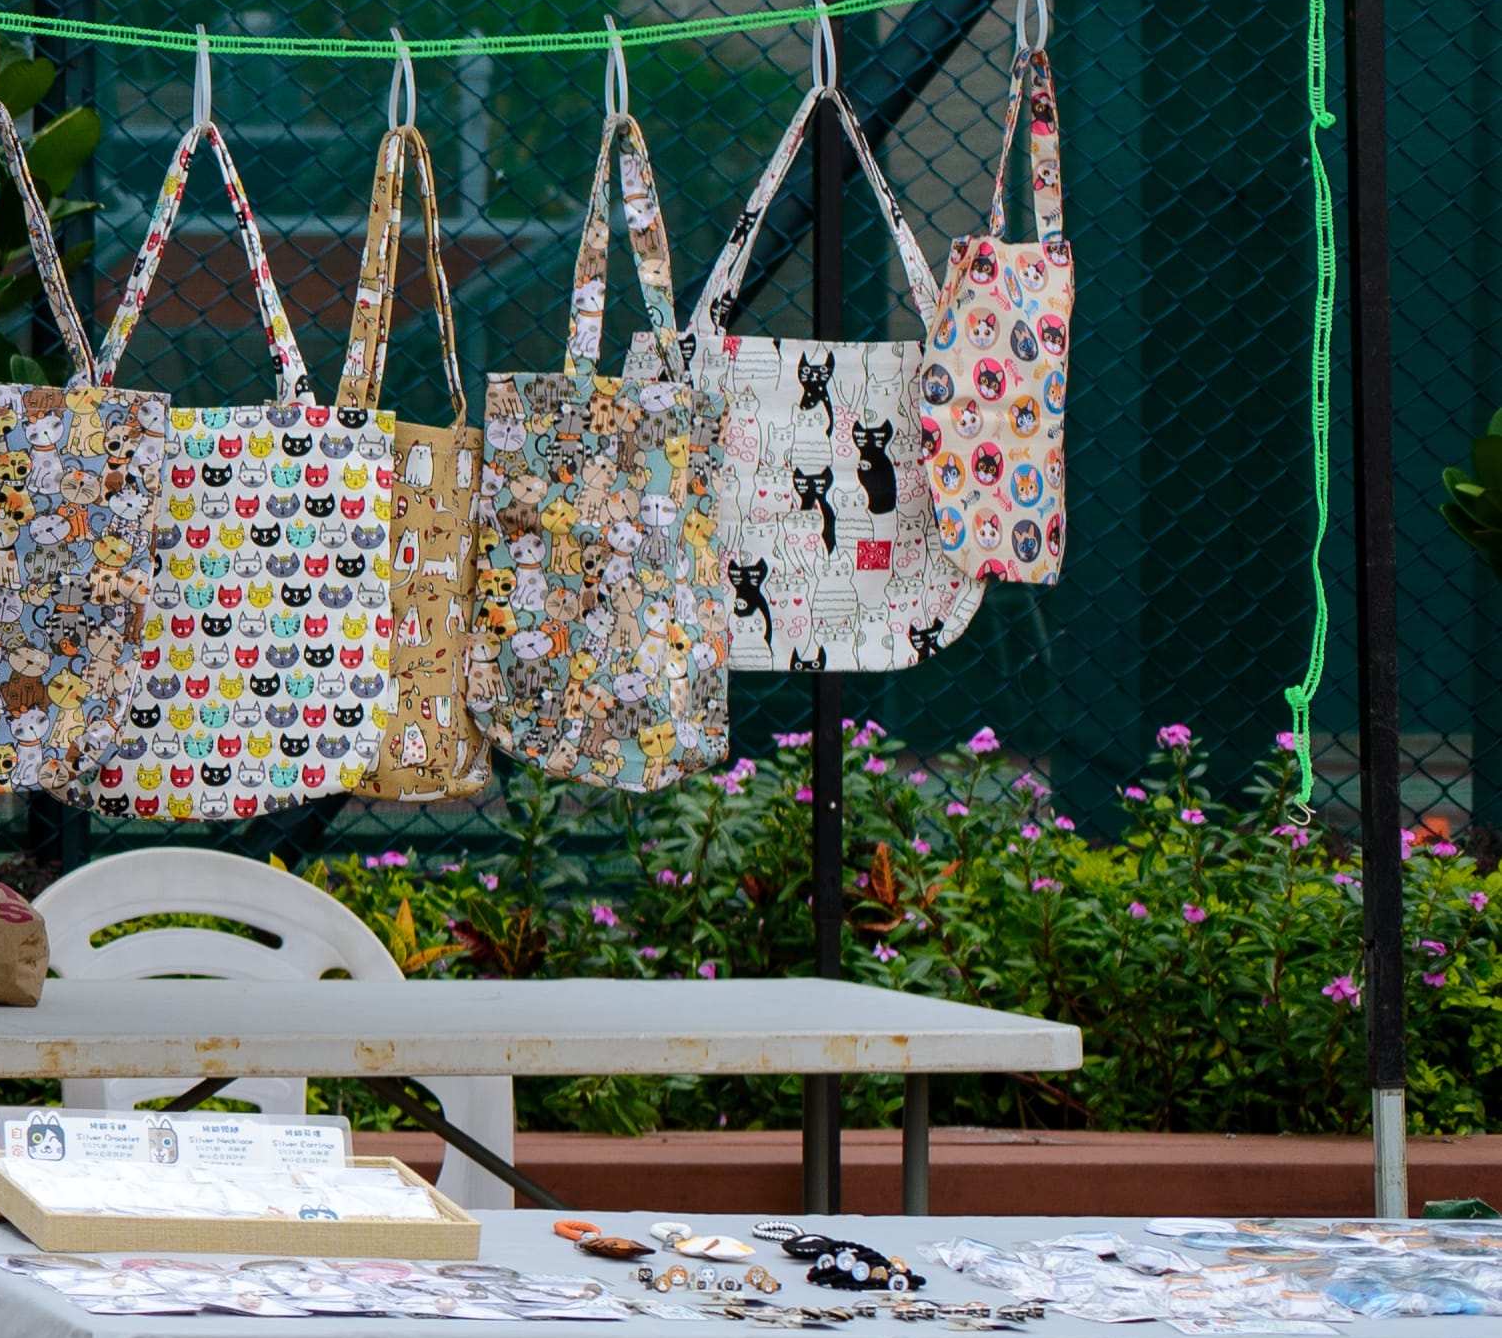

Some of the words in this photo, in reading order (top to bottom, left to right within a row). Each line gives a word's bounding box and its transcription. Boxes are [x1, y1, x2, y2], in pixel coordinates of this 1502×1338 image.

[76, 1133, 102, 1142] Silver
[188, 1135, 215, 1144] Silver
[217, 1137, 254, 1146] Necklace
[272, 1139, 298, 1148] Silver
